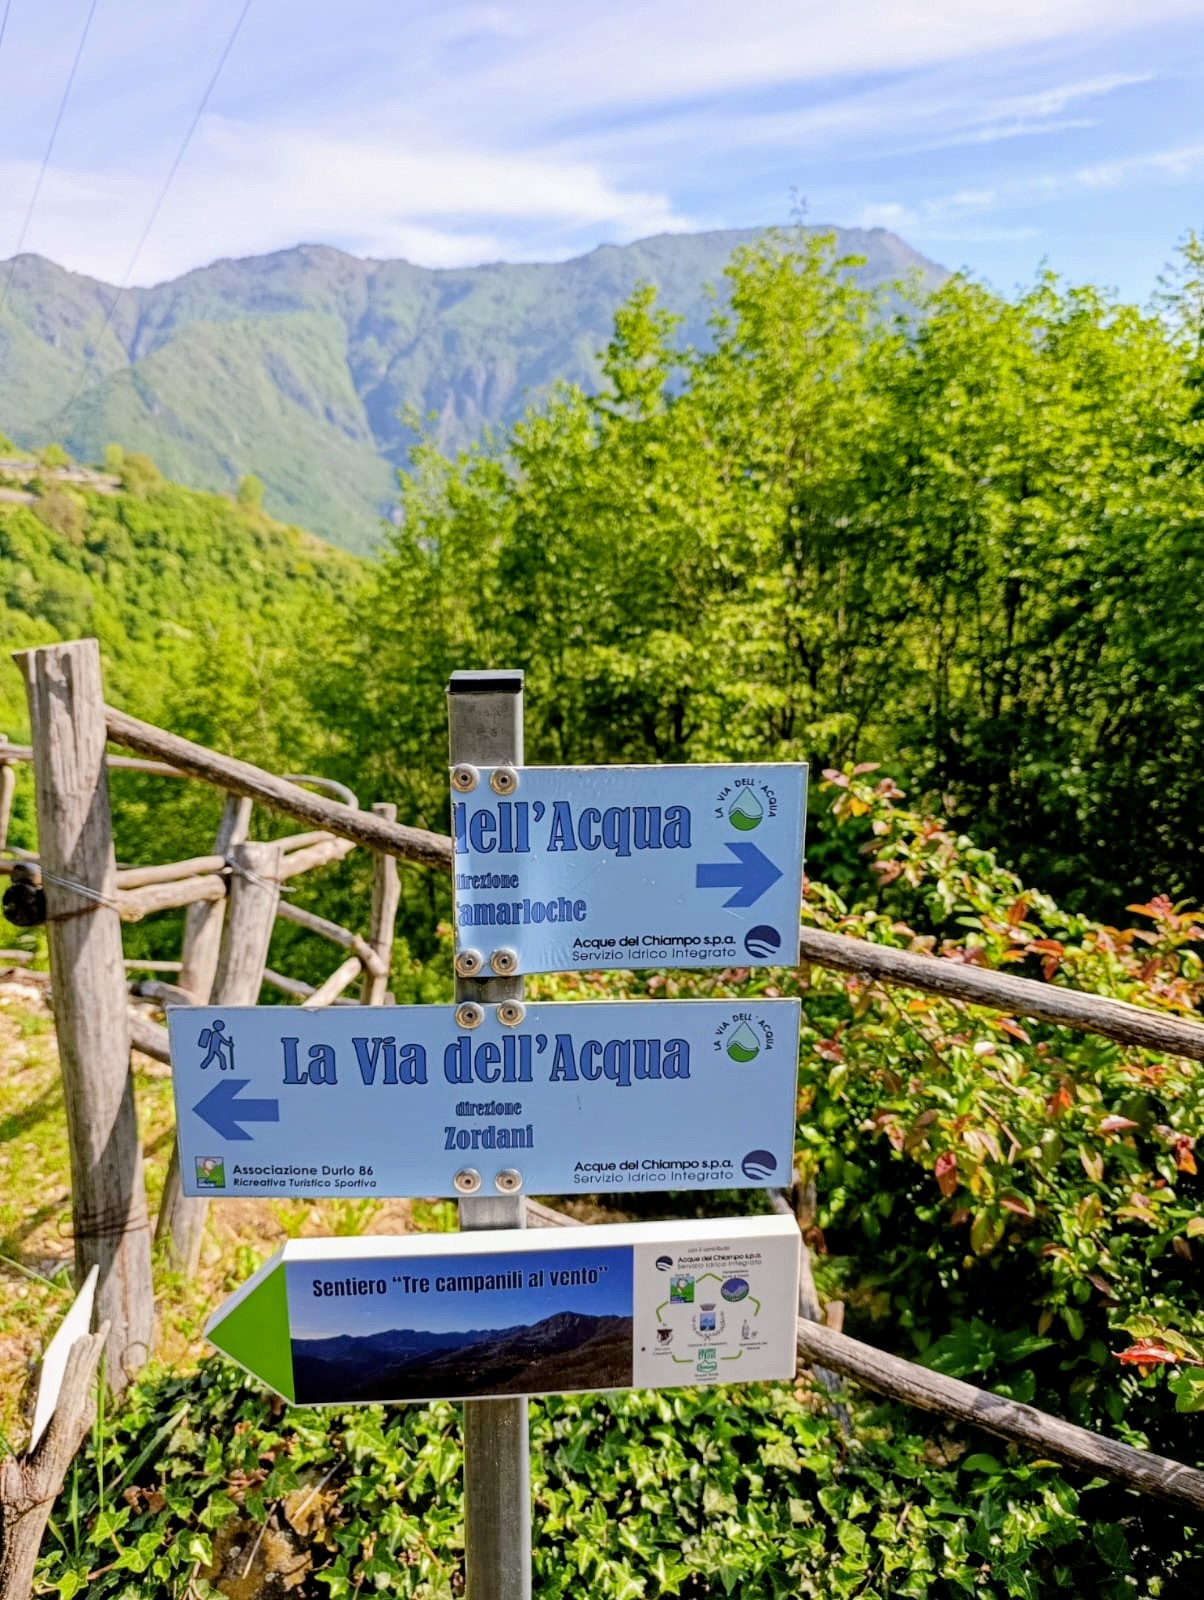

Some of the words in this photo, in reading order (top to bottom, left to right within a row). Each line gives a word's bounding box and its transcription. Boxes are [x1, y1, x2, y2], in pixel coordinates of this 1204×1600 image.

[716, 787, 732, 801] VIA
[456, 896, 588, 927] amarloche
[572, 937, 616, 949] Acque
[618, 936, 639, 947] del
[642, 935, 701, 947] Chiampo
[703, 935, 737, 946] s.p.a.
[572, 949, 624, 961] Servizio
[628, 948, 668, 960] Idrico
[672, 947, 737, 960] Integrato
[715, 1021, 731, 1035] VIA
[281, 1037, 338, 1085] La
[351, 1036, 428, 1086] Via
[443, 1034, 691, 1087] dell'Acqua
[455, 1100, 522, 1117] direzione
[444, 1124, 535, 1151] Zordani
[233, 1164, 318, 1176] Associazione
[322, 1165, 355, 1176] Durlo
[359, 1165, 374, 1176] 86
[573, 1161, 616, 1173] Acque
[619, 1160, 639, 1171] del
[641, 1159, 699, 1171] Chiampo
[702, 1159, 734, 1170] s.p.a.
[233, 1178, 286, 1187] Ricreativa
[289, 1178, 331, 1188] Turistico
[334, 1178, 377, 1189] Sportiva
[573, 1173, 624, 1184] Servizio
[628, 1172, 667, 1183] Idrico
[671, 1170, 734, 1182] Integrato
[312, 1277, 388, 1298] Sentiero
[435, 1270, 523, 1294] campanili
[528, 1269, 544, 1289] al
